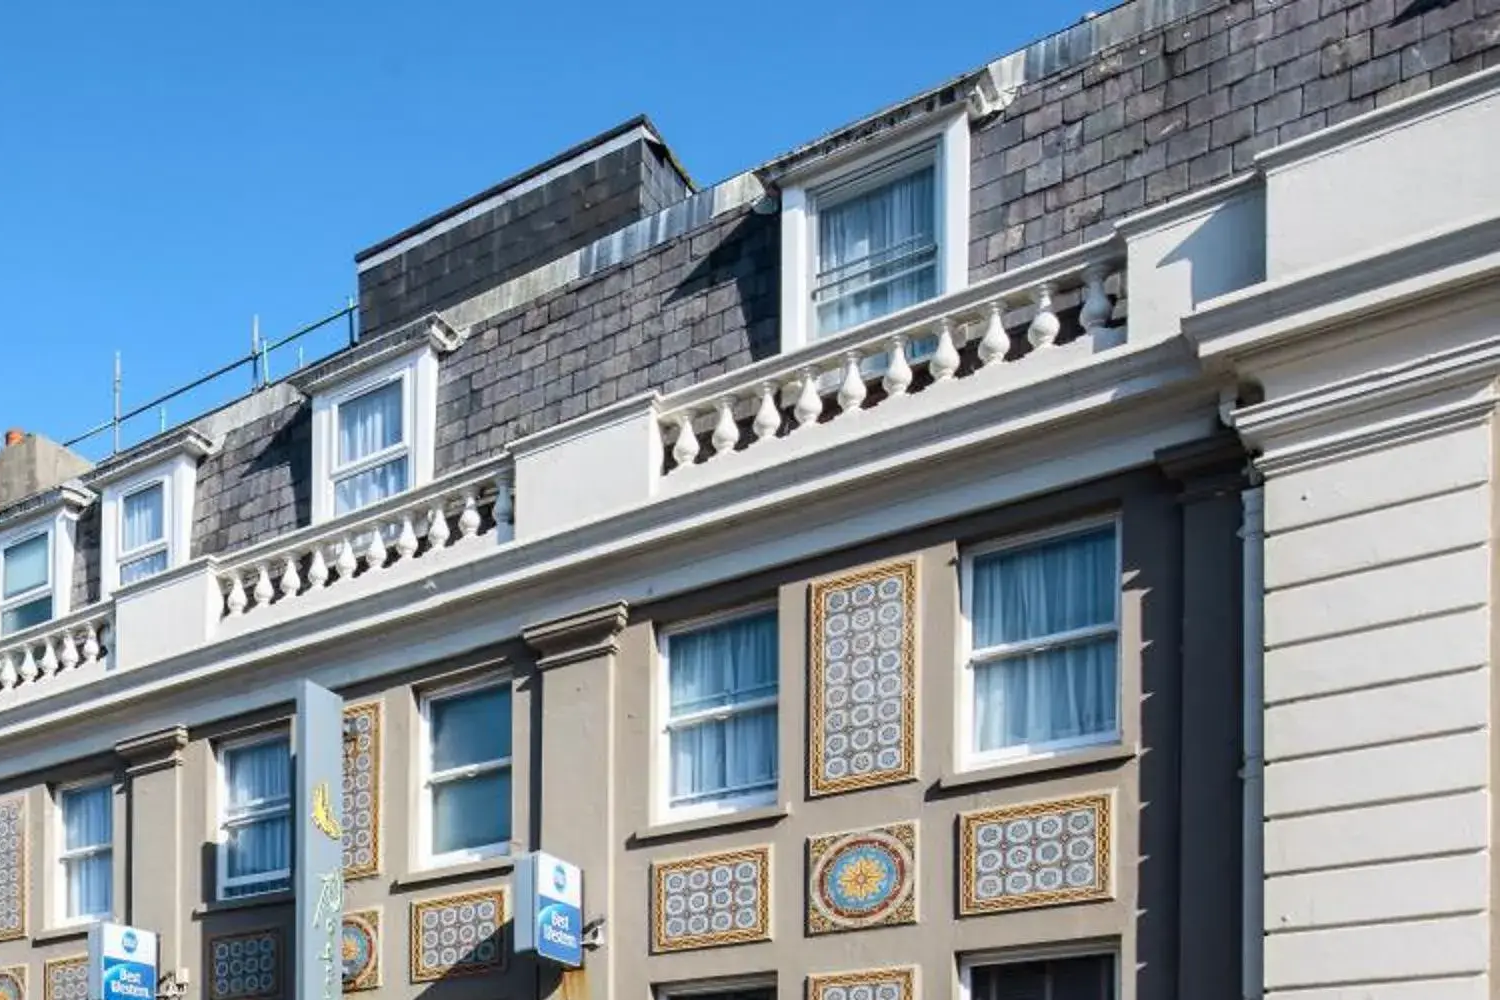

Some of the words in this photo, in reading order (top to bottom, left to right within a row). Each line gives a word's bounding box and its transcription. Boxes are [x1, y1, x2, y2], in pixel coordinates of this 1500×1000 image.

[551, 909, 569, 931] Best
[543, 923, 578, 949] Western
[119, 967, 141, 984] Best
[111, 979, 150, 998] Western
